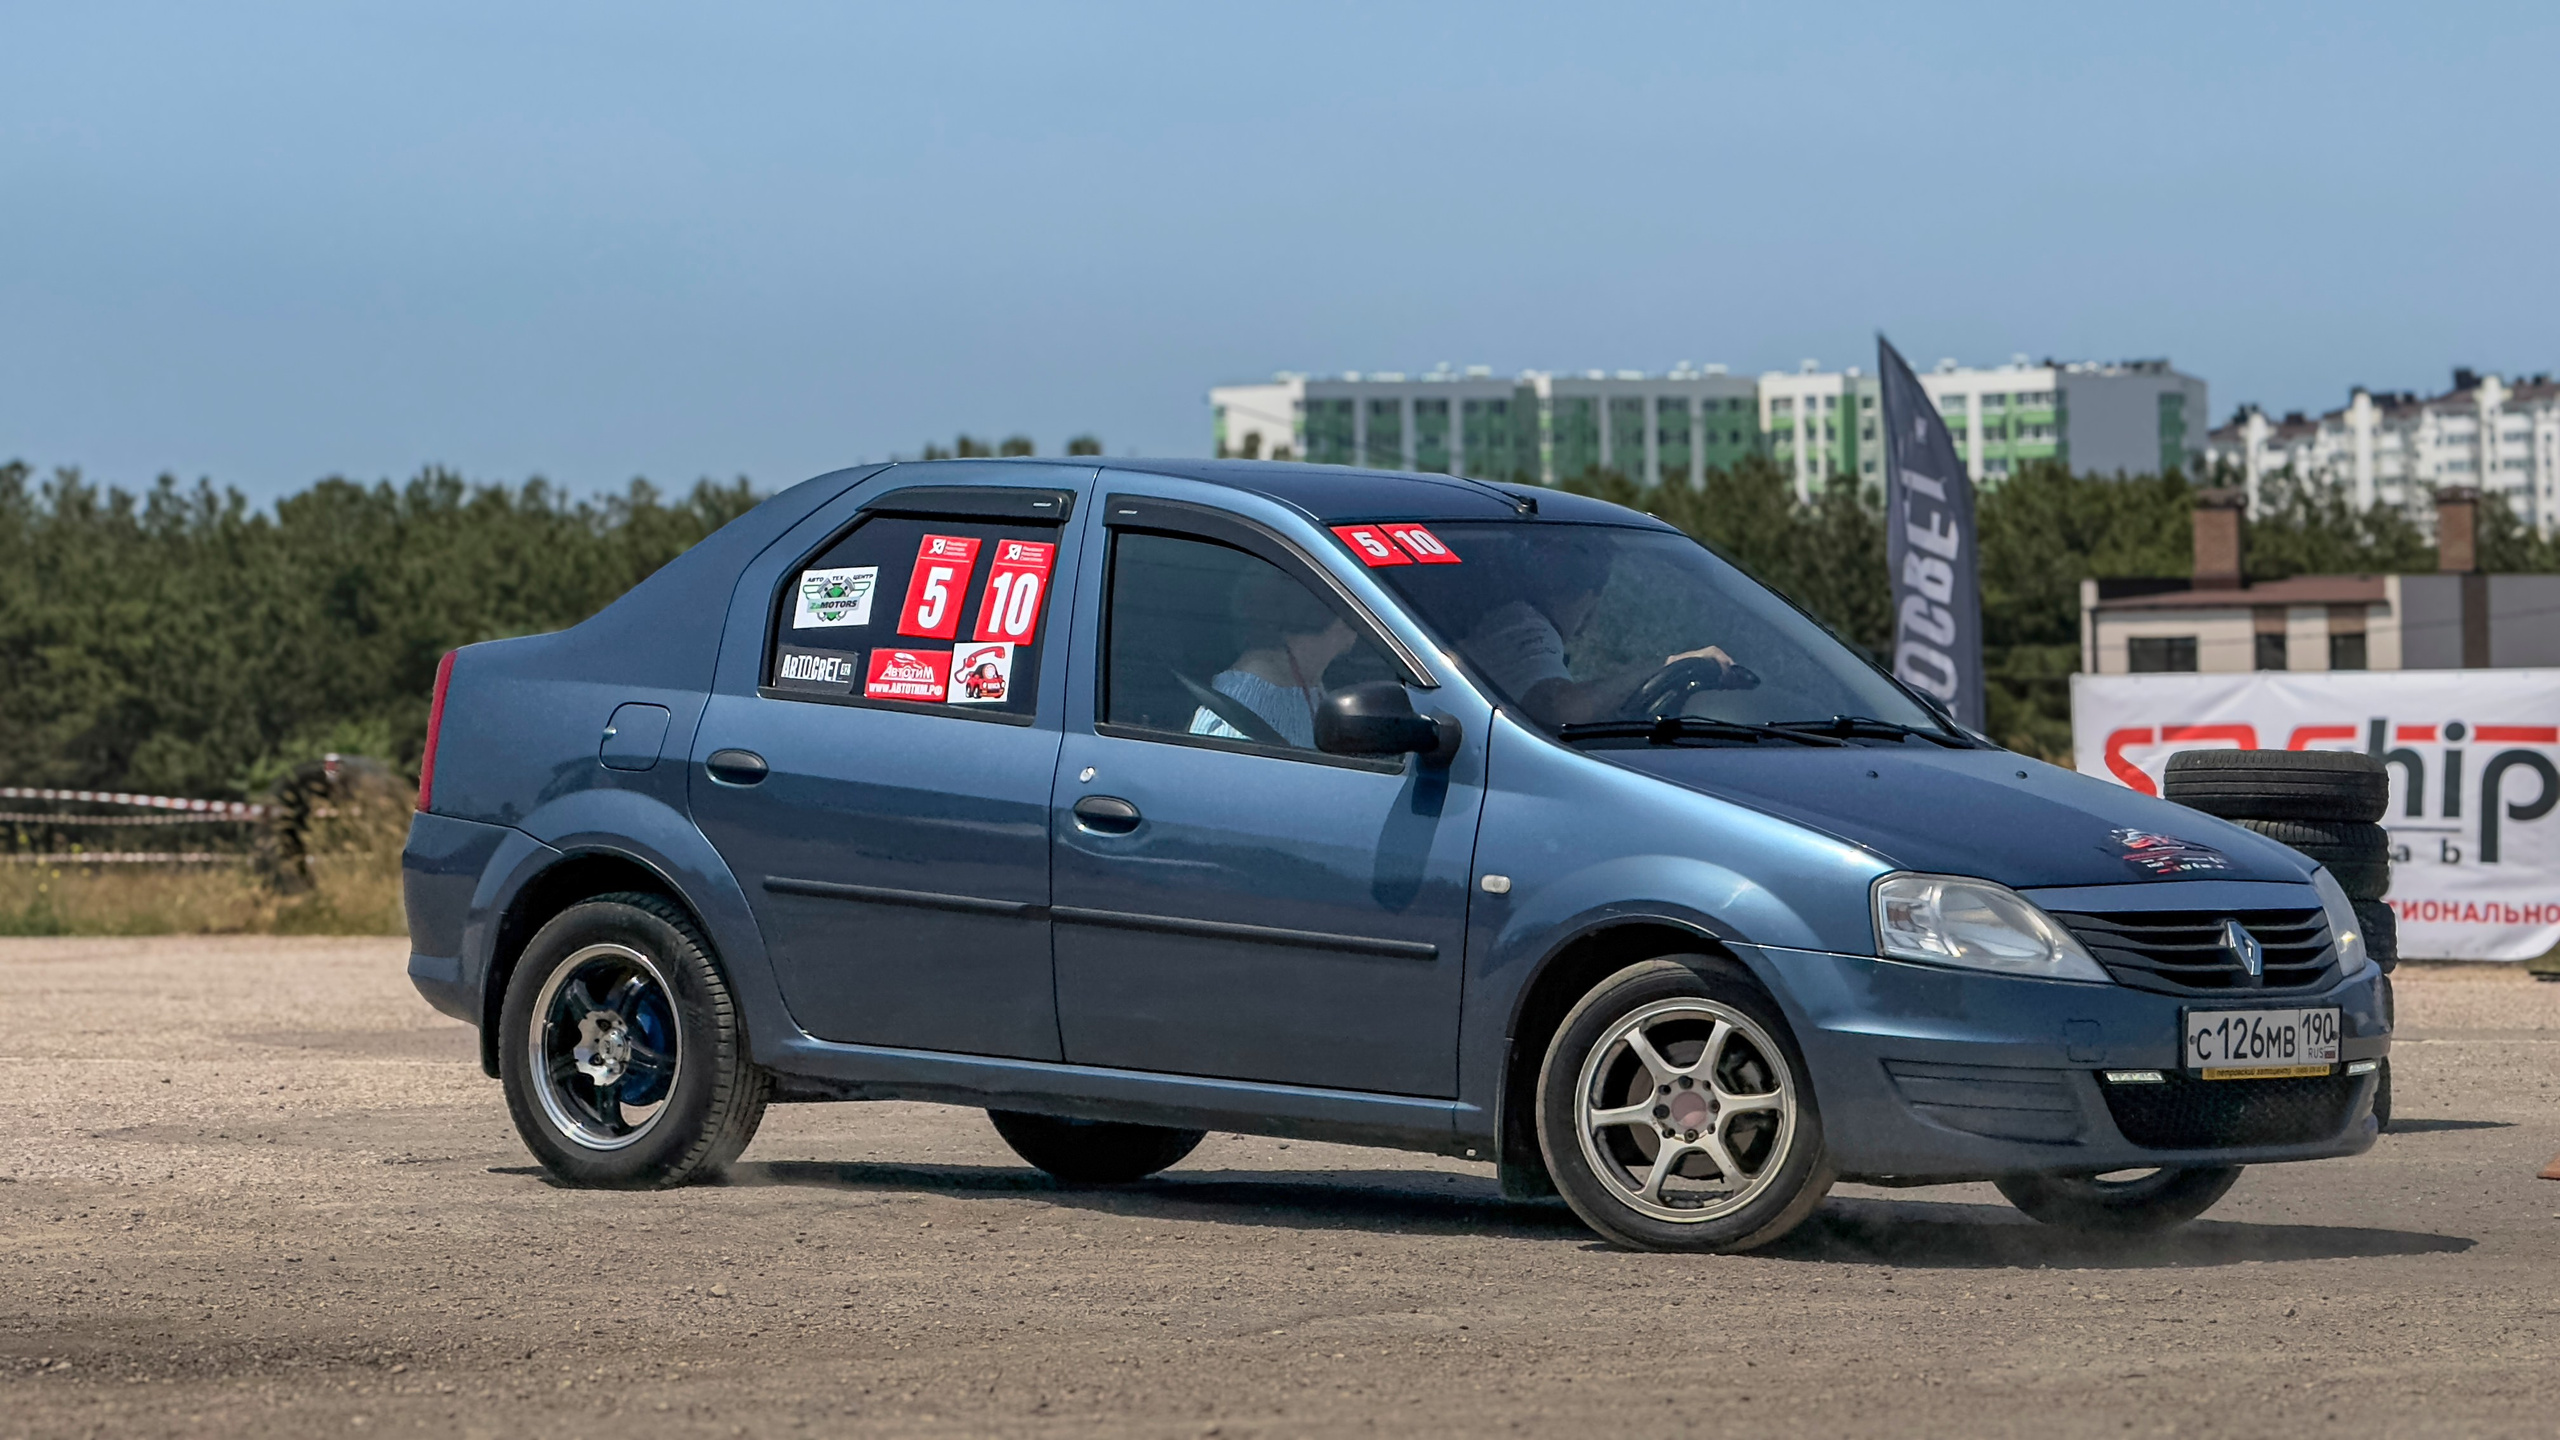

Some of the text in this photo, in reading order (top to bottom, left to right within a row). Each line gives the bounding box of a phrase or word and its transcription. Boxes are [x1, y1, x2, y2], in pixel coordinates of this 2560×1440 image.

[1351, 529, 1446, 557] 5 10
[917, 566, 953, 629] 5
[987, 572, 1039, 636] 10
[1896, 467, 1959, 720] ОСВЕТ
[2389, 901, 2560, 924] ИОНАЛЬНО
[2302, 1012, 2333, 1045] 190
[2308, 1047, 2324, 1059] RUS
